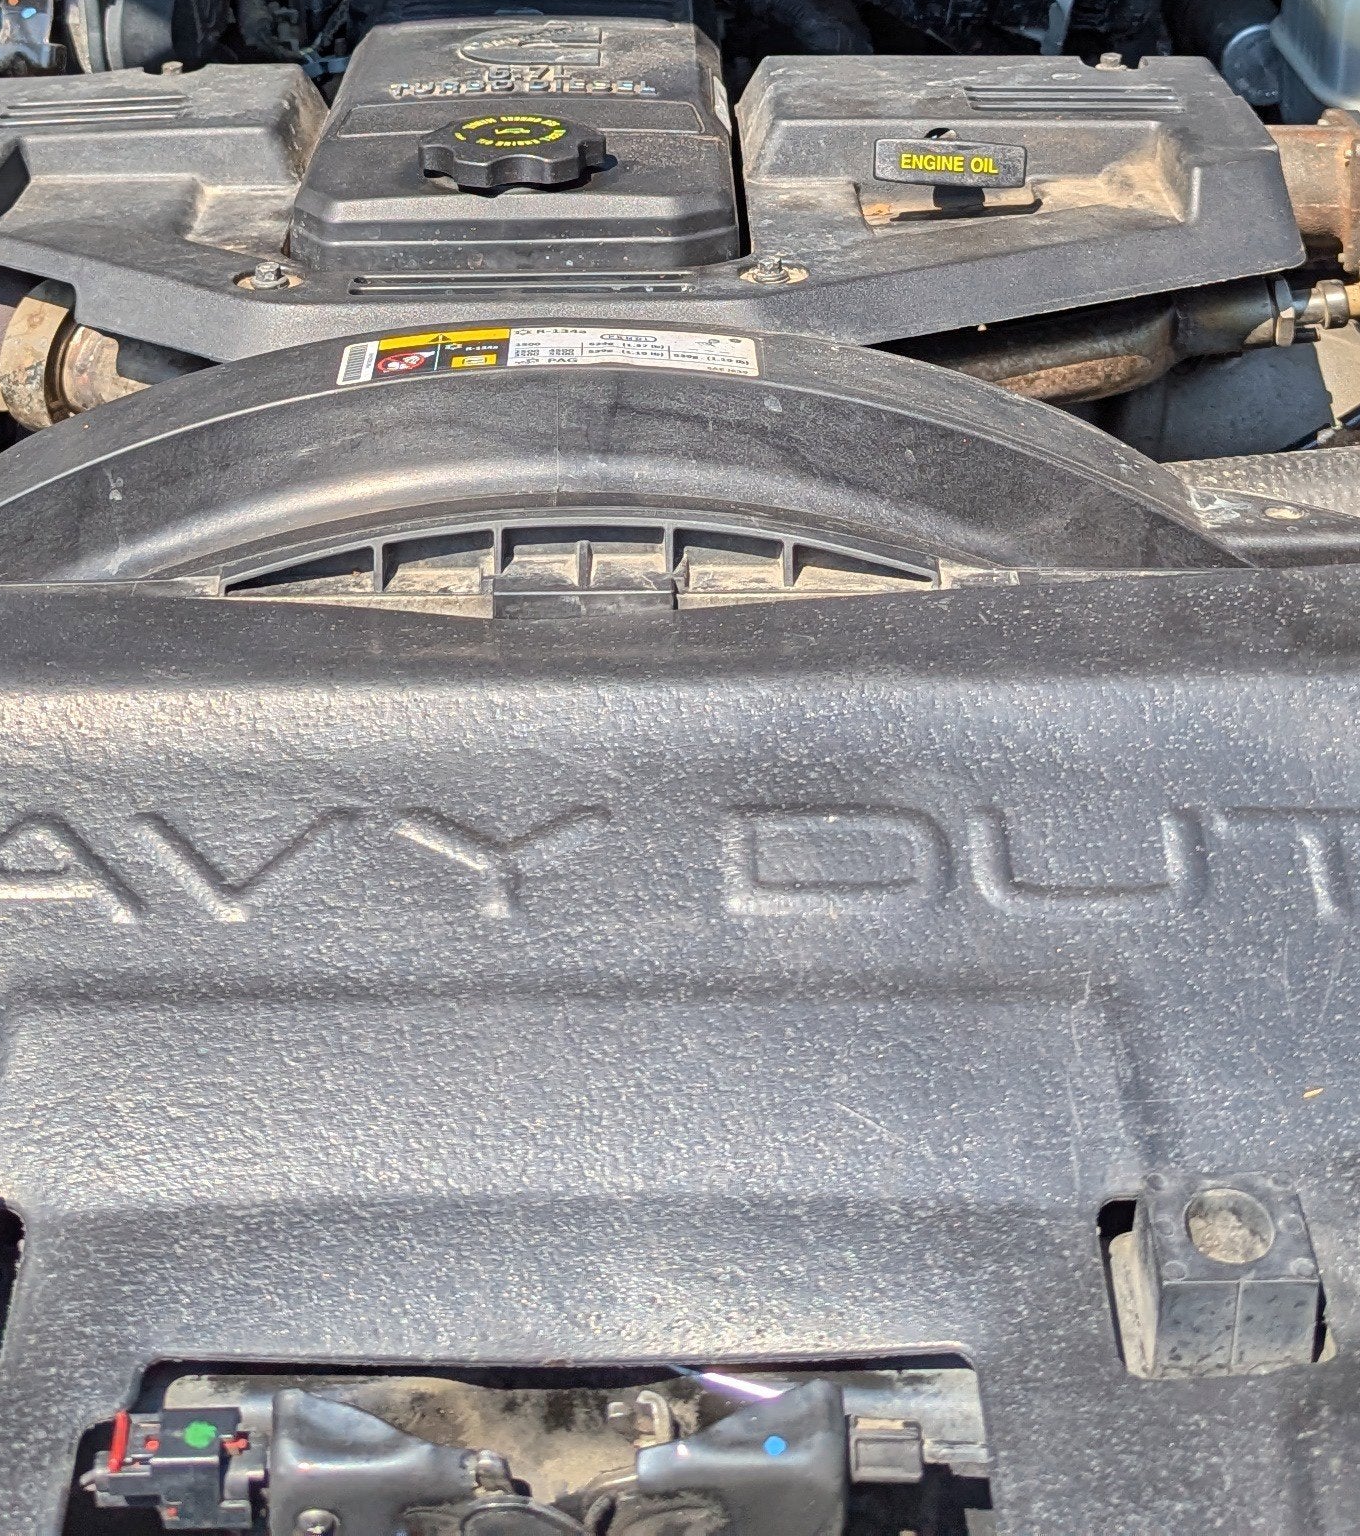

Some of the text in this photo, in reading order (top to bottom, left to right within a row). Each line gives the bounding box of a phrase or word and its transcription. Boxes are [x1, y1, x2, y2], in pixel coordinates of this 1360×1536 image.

[390, 78, 657, 98] TURBO DIESEL
[901, 153, 1000, 174] ENGINE OIL
